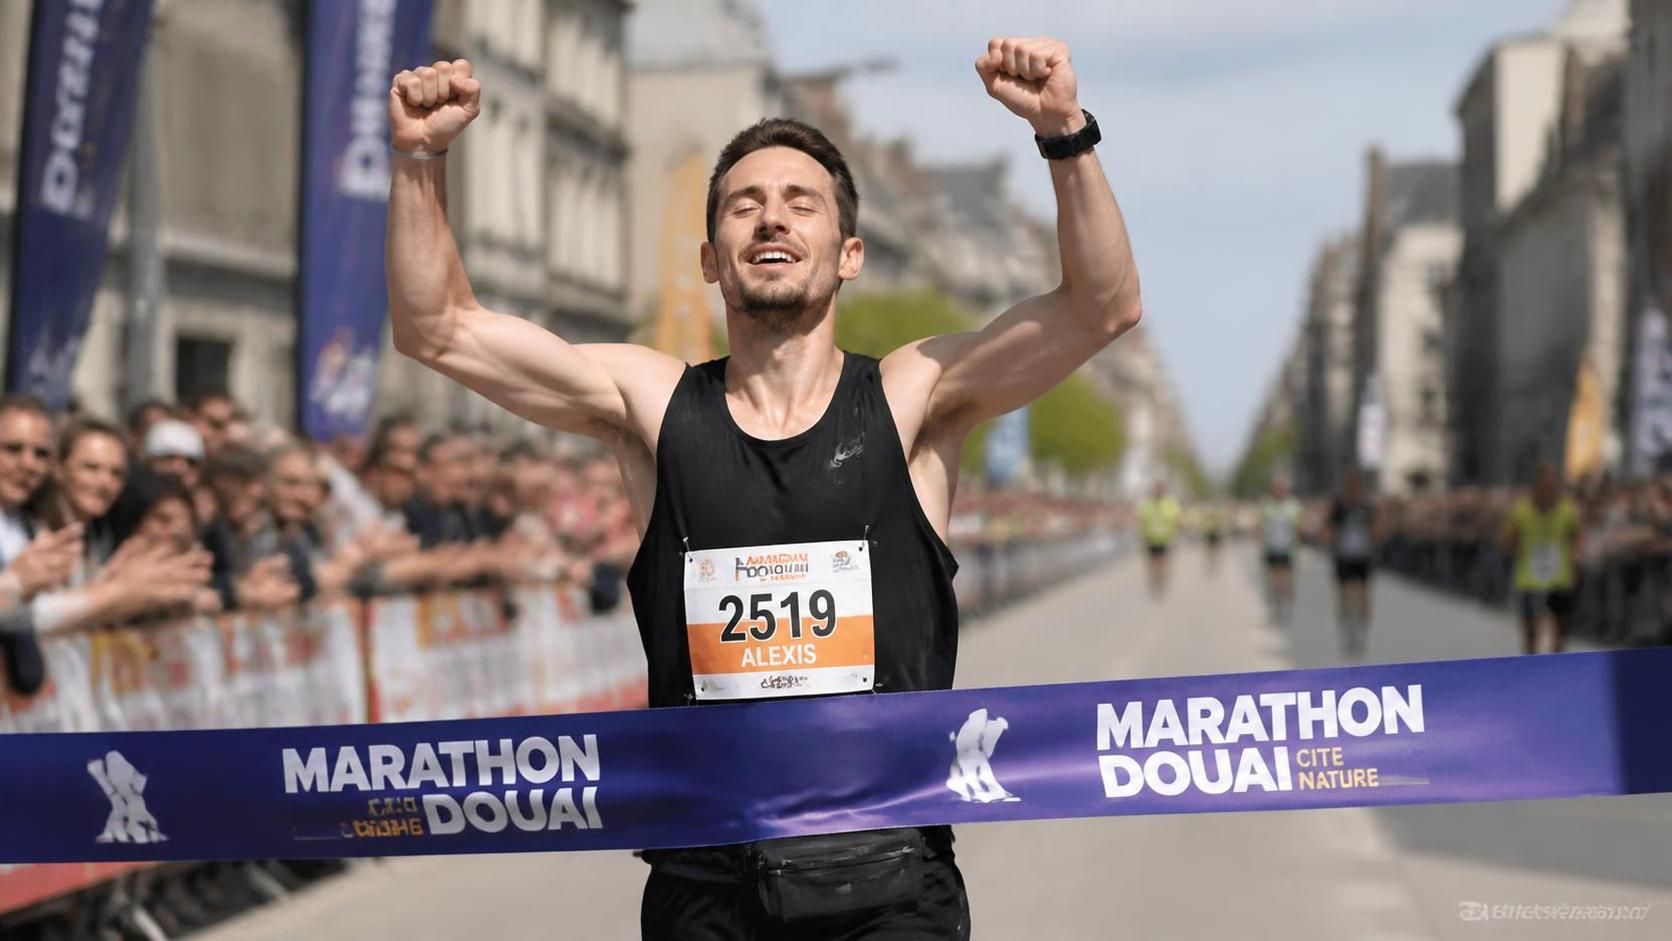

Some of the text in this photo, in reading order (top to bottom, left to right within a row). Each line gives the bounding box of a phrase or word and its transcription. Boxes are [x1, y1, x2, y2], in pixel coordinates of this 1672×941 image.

[719, 589, 836, 642] 2519
[741, 643, 817, 668] ALEXIS
[1097, 684, 1425, 750] MARATHON
[282, 734, 600, 793] MARATHON
[1099, 746, 1293, 798] DOUAI
[1297, 747, 1344, 769] CITE
[1298, 768, 1380, 791] NATURE
[422, 786, 603, 835] DOUAI
